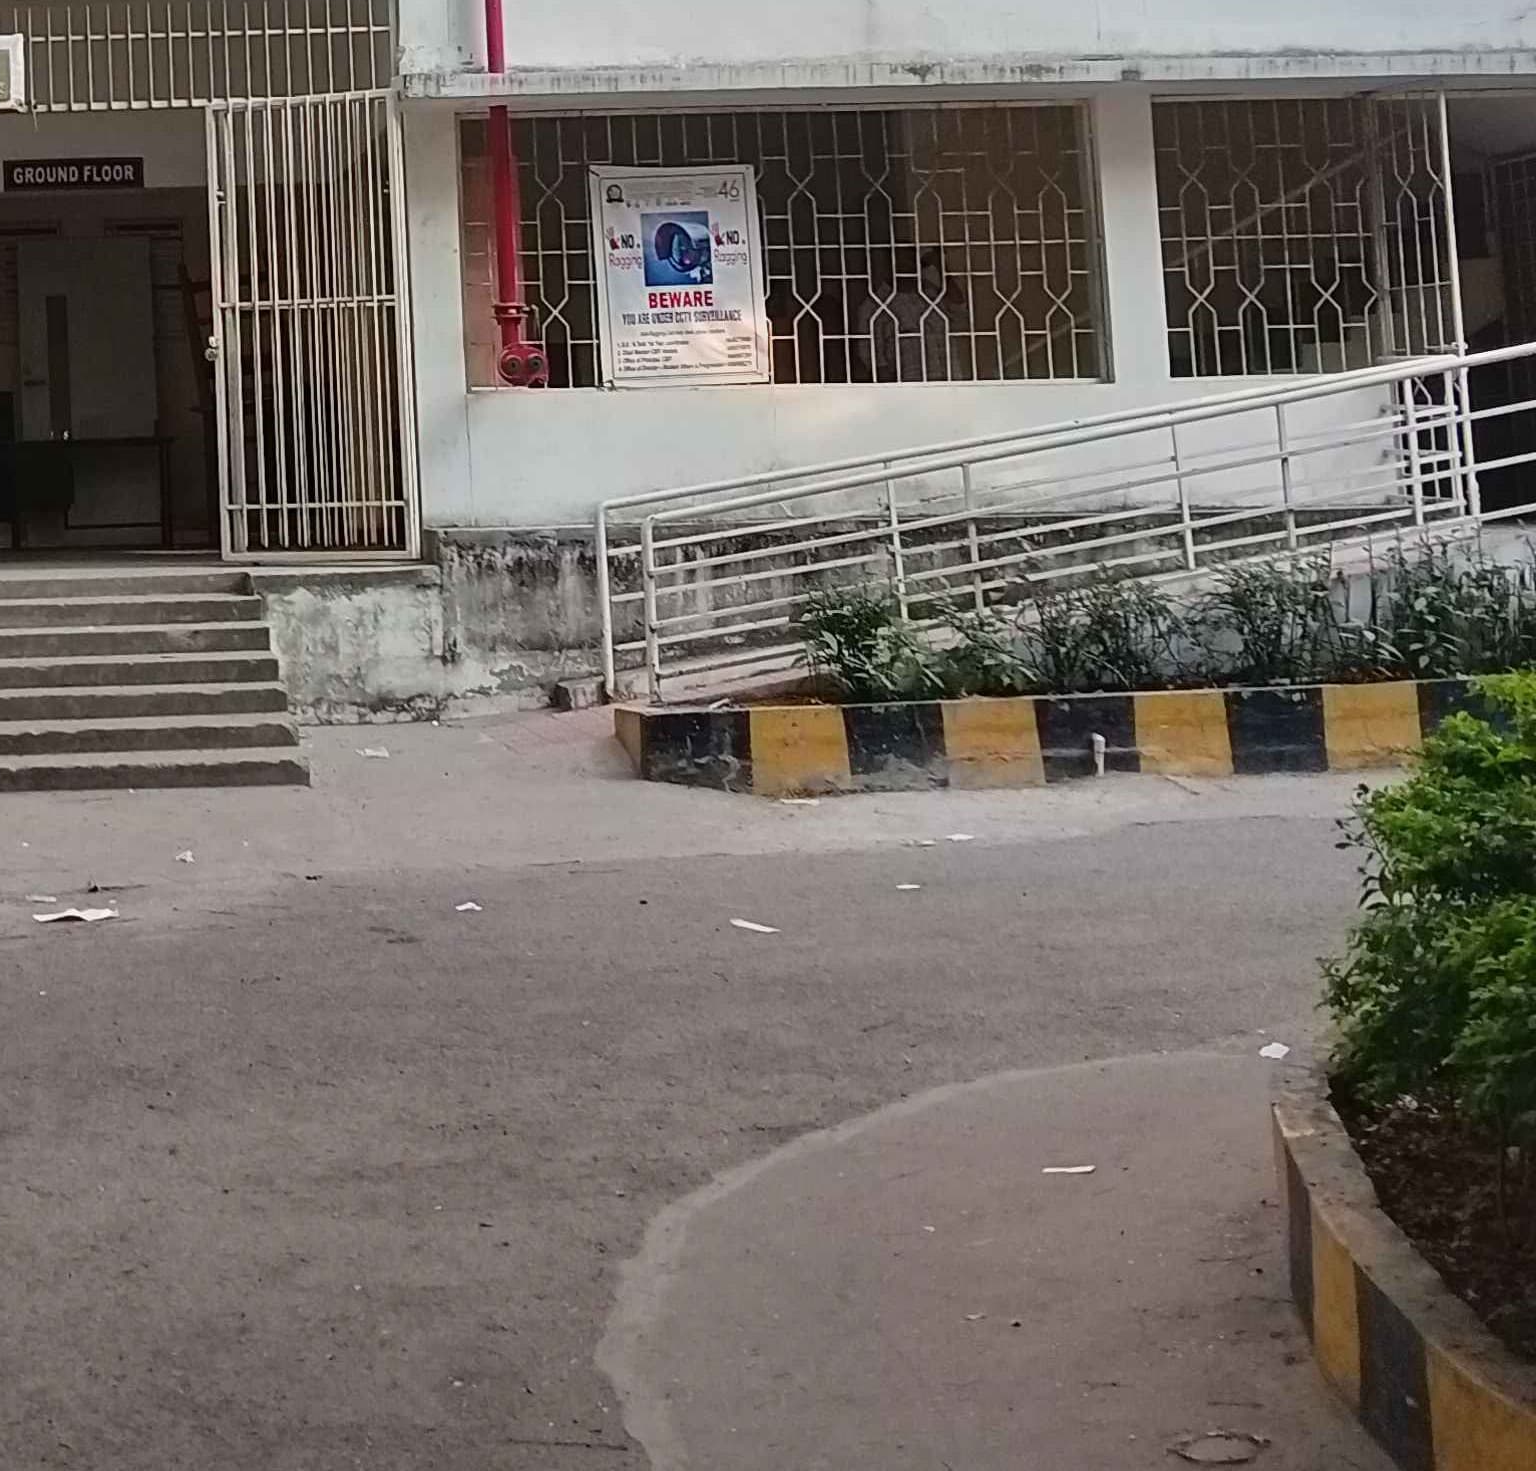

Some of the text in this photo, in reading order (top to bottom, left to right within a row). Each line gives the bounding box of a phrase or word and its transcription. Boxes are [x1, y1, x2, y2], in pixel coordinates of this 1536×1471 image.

[13, 164, 134, 184] GROUND FLOOR
[648, 291, 714, 309] BEWARE
